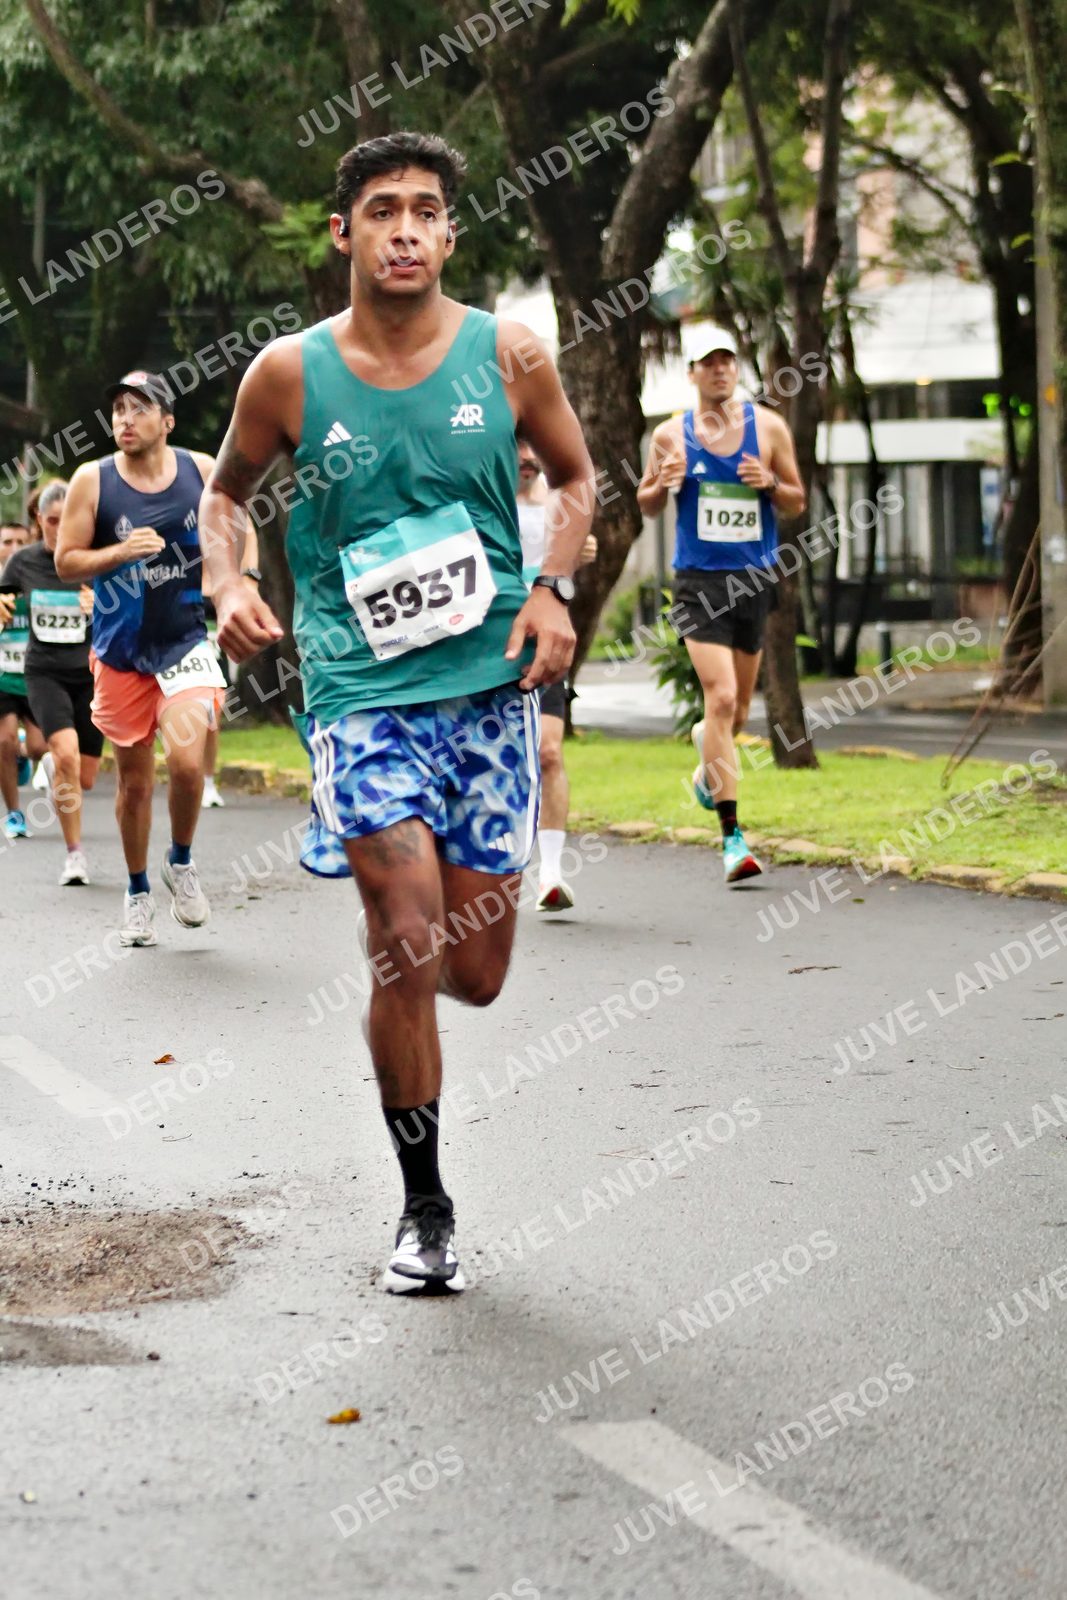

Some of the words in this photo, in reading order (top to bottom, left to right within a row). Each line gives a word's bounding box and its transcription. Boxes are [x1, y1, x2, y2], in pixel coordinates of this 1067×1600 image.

[705, 509, 757, 527] 1028
[363, 555, 476, 628] 5937
[36, 613, 81, 629] 6223
